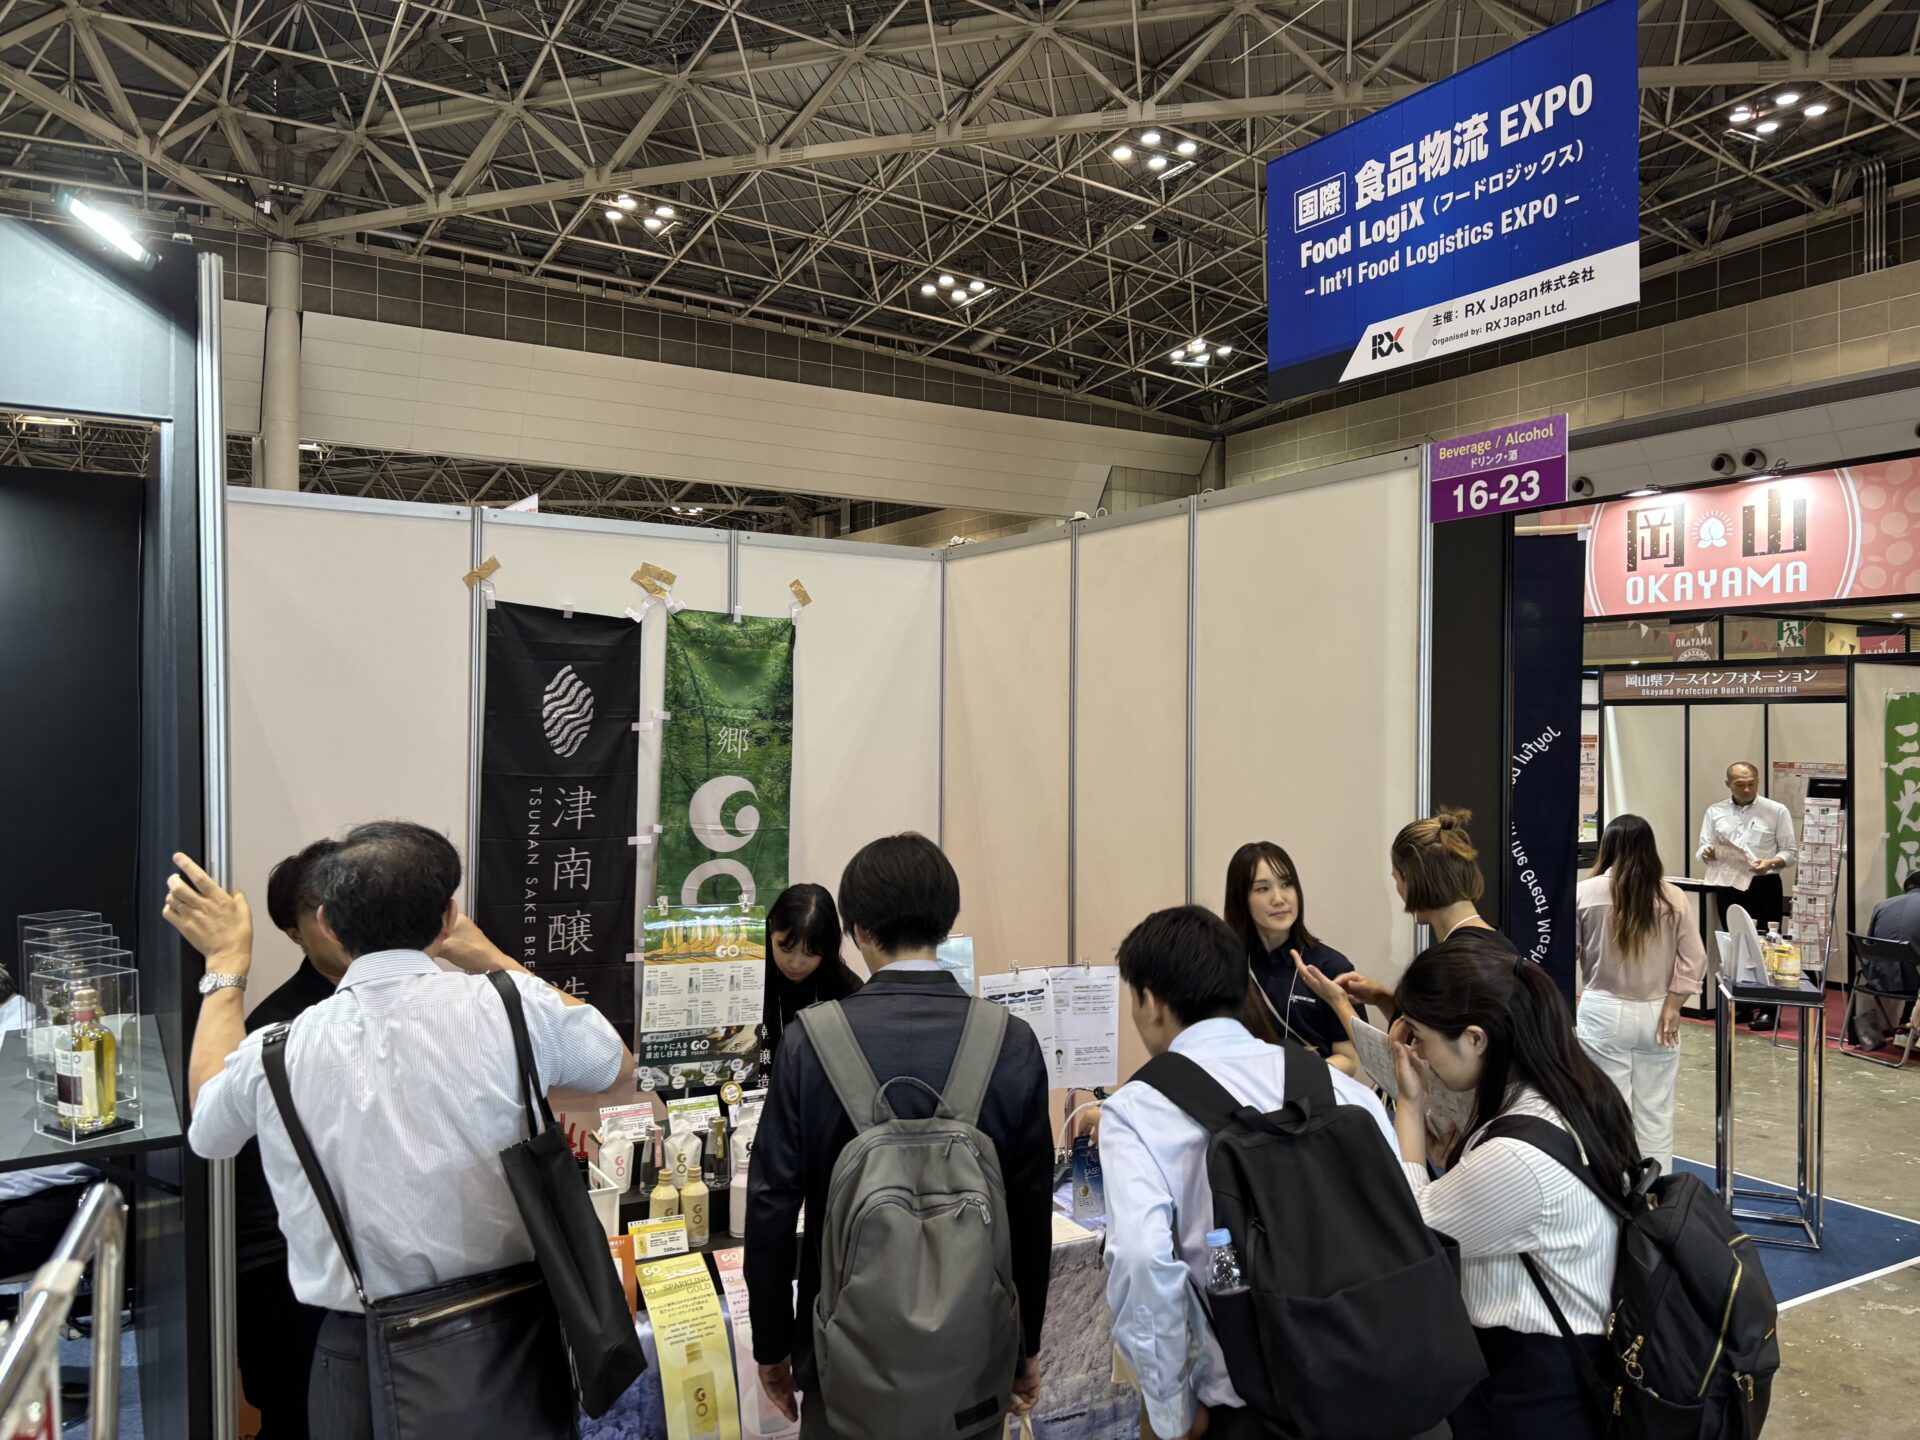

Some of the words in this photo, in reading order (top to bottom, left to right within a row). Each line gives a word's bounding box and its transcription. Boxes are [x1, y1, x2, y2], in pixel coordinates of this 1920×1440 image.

[1298, 180, 1342, 227] 国際
[1354, 112, 1489, 211] 食品物流
[1500, 73, 1593, 147] EXPO
[1300, 226, 1352, 268] Food
[1359, 197, 1425, 248] LogiX
[1358, 244, 1400, 284] Food
[1405, 222, 1494, 268] Logistics
[1501, 193, 1558, 235] EXPO
[1432, 330, 1469, 346] Organised
[1485, 319, 1502, 333] RX
[1503, 311, 1541, 328] Japan
[1544, 300, 1567, 317] Ltd.
[1464, 299, 1486, 318] RX
[1439, 440, 1491, 460] Beverage
[1505, 423, 1554, 446] Alcohol
[1453, 470, 1540, 512] 16-23
[1626, 561, 1808, 605] OKAYAMA
[1676, 636, 1712, 647] OKAYAMA
[1625, 669, 1818, 687] 岡山県ブースインフォメーション
[1641, 688, 1674, 696] Okayama
[1676, 687, 1718, 695] Prefecture
[1721, 686, 1744, 694] Booth
[1747, 685, 1797, 693] Information
[717, 726, 749, 759] 郷
[527, 786, 543, 865] TSUNAN
[524, 876, 538, 924] SAKE
[524, 936, 536, 976] BRE
[663, 1275, 710, 1292] SPARKLING
